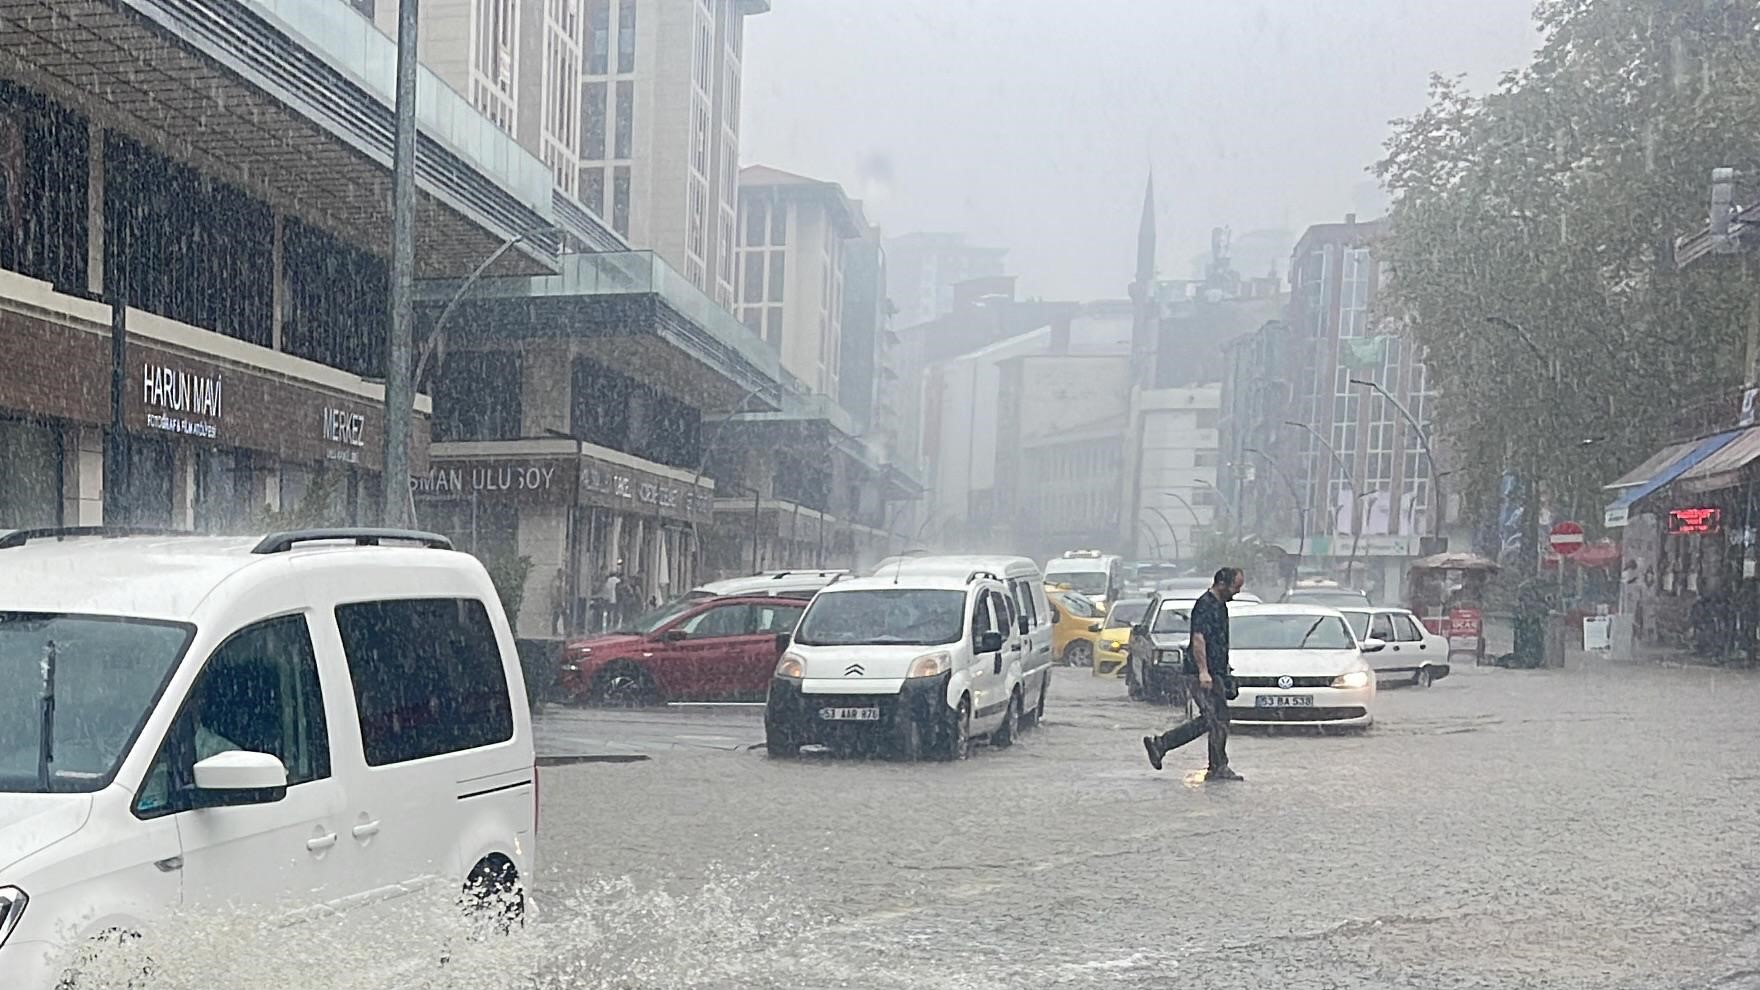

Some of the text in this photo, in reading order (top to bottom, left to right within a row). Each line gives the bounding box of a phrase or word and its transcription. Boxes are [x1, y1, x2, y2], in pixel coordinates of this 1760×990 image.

[144, 363, 222, 418] HARUN MAVİ
[323, 407, 364, 446] MERKEZ
